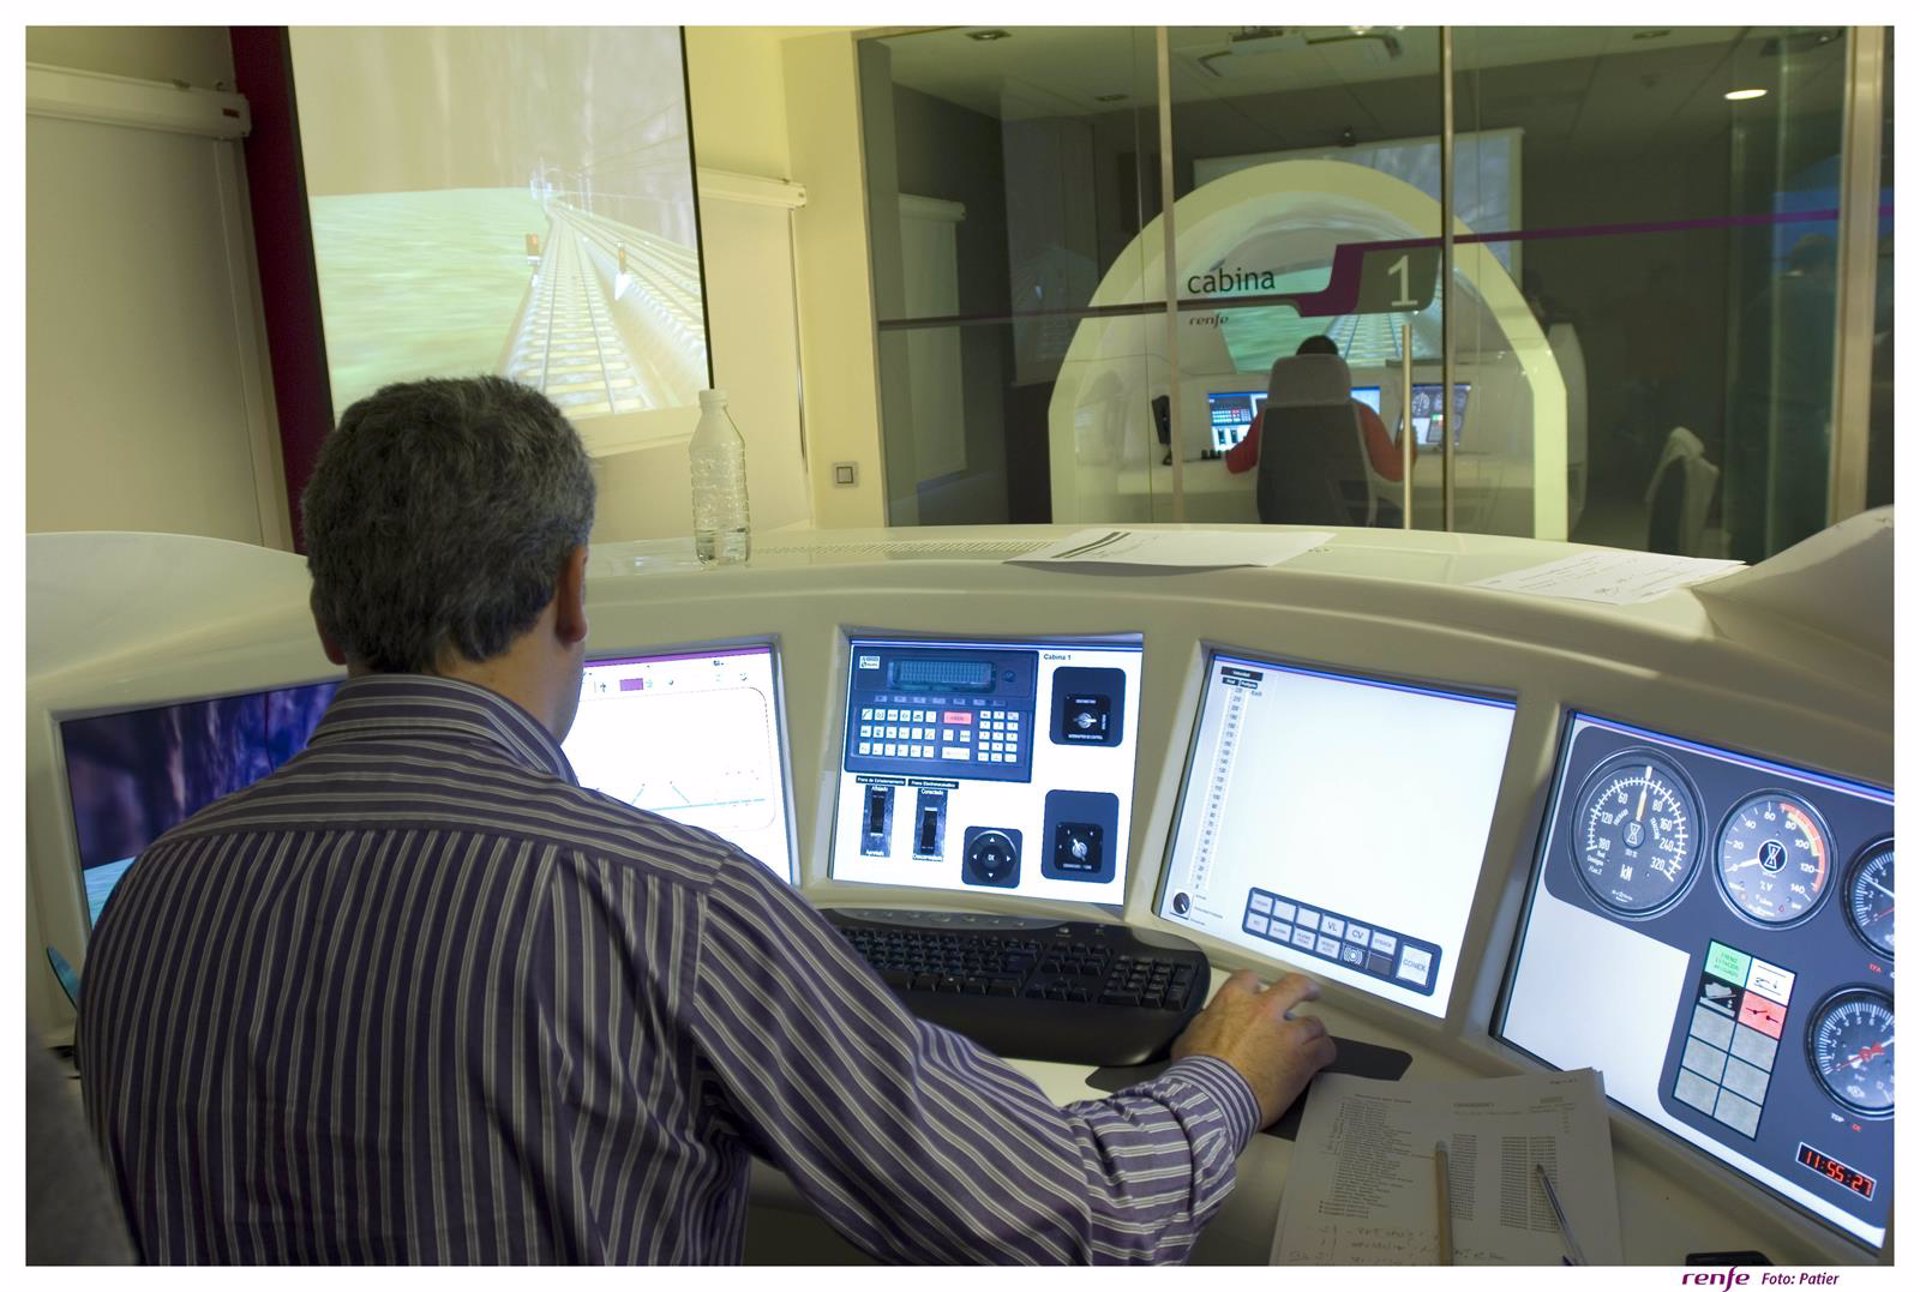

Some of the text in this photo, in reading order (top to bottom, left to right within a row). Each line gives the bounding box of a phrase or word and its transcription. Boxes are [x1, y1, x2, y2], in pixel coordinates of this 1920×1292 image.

[1187, 255, 1418, 307] cabina 1
[1043, 653, 1066, 661] Cabina
[1618, 791, 1628, 804] 60
[1652, 799, 1663, 813] 80
[1601, 811, 1613, 825] 120
[1764, 811, 1776, 821] 60
[1659, 817, 1673, 832] 160
[1745, 819, 1756, 830] 40
[1784, 820, 1797, 831] 80
[1659, 837, 1674, 852] 240
[1732, 840, 1744, 850] 20
[1795, 840, 1810, 850] 100
[988, 854, 995, 862] OK
[1650, 857, 1665, 872] 320
[1800, 863, 1815, 873] 120
[1790, 883, 1805, 894] 140
[1328, 921, 1338, 932] VL
[1352, 929, 1365, 939] CV
[1857, 1017, 1862, 1025] 5
[1831, 1039, 1838, 1048] 2
[1805, 1150, 1873, 1196] 11:55:27
